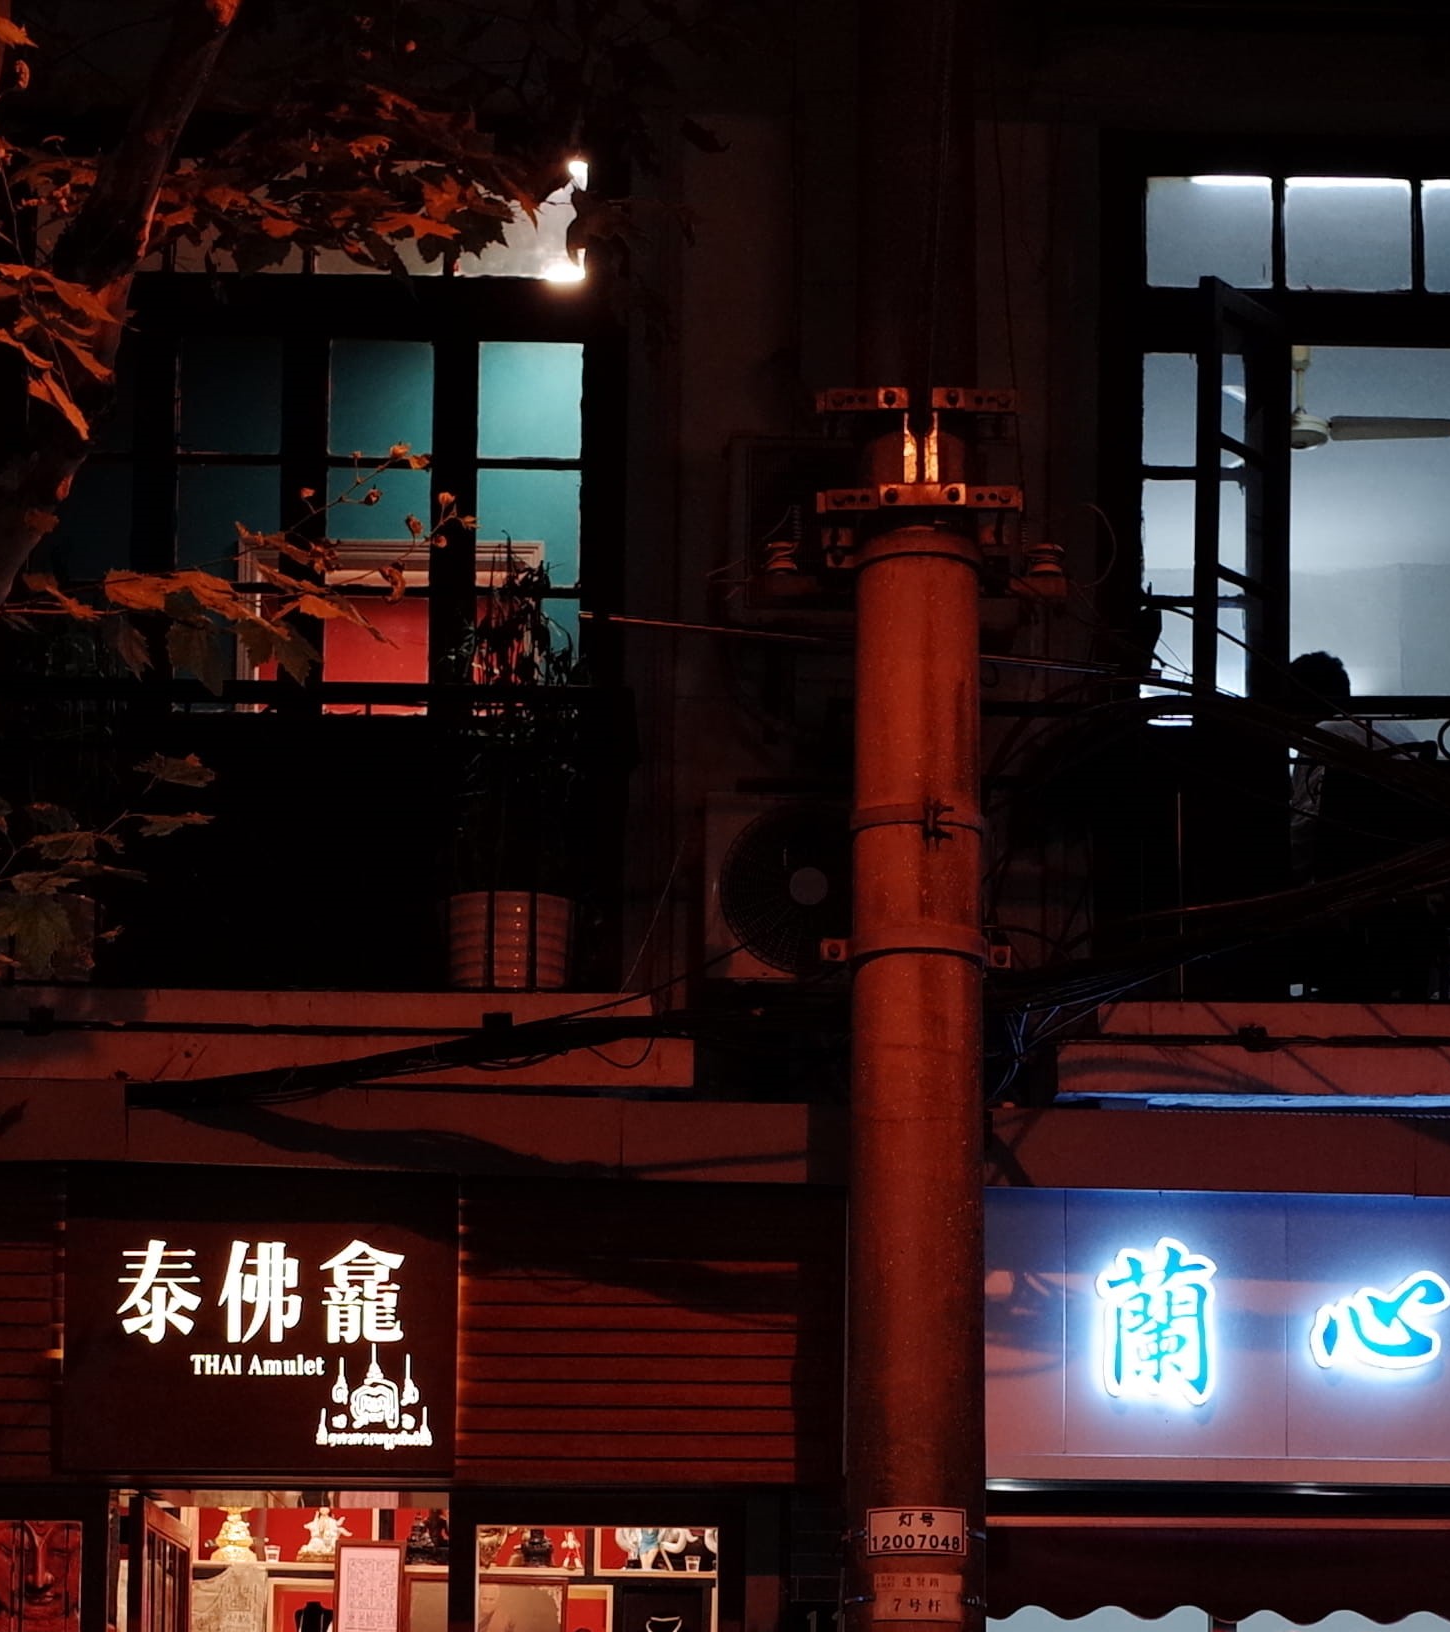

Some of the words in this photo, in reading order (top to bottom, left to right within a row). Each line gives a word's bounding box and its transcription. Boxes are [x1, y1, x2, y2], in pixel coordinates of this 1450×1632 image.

[190, 1354, 242, 1376] THAI
[248, 1354, 325, 1376] Amulet
[898, 1512, 935, 1527] 灯号
[872, 1534, 960, 1551] 12007048
